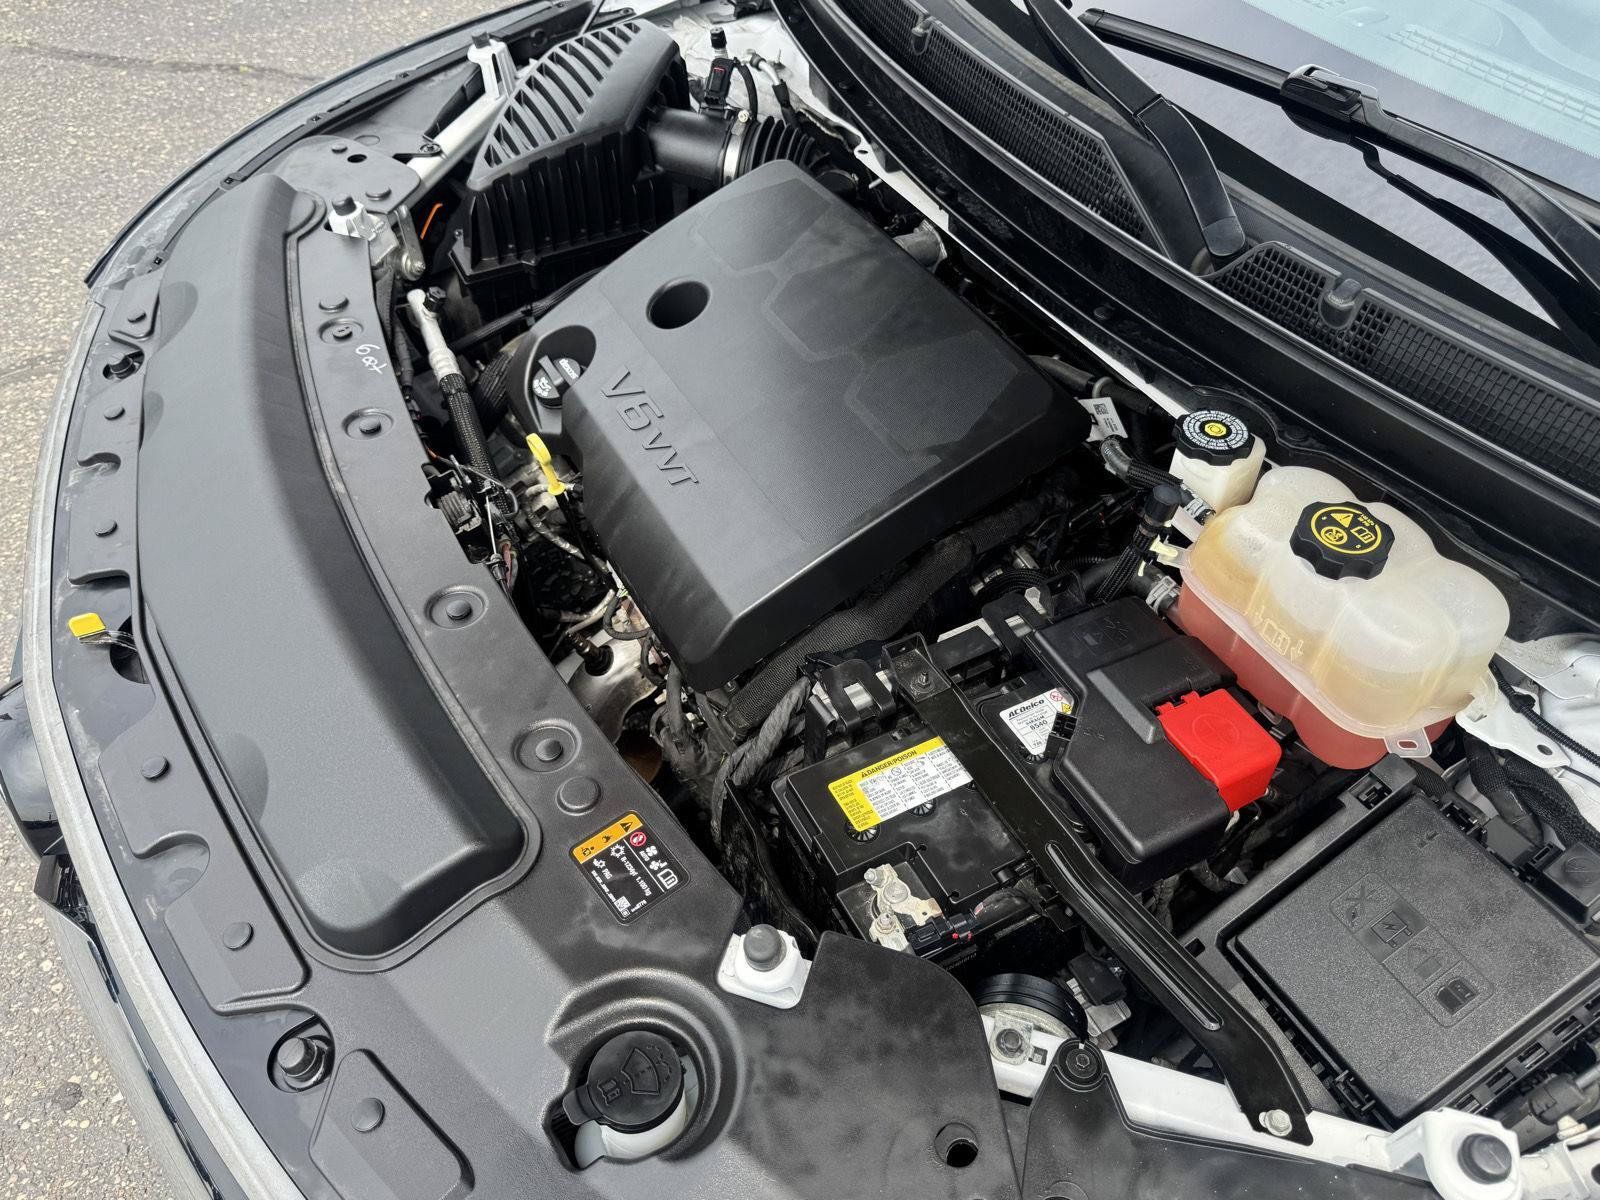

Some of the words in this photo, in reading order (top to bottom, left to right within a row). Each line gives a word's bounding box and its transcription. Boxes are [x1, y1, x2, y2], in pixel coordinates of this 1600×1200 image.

[601, 365, 664, 431] V6
[642, 429, 699, 487] VVT
[1009, 699, 1045, 718] ACDelco
